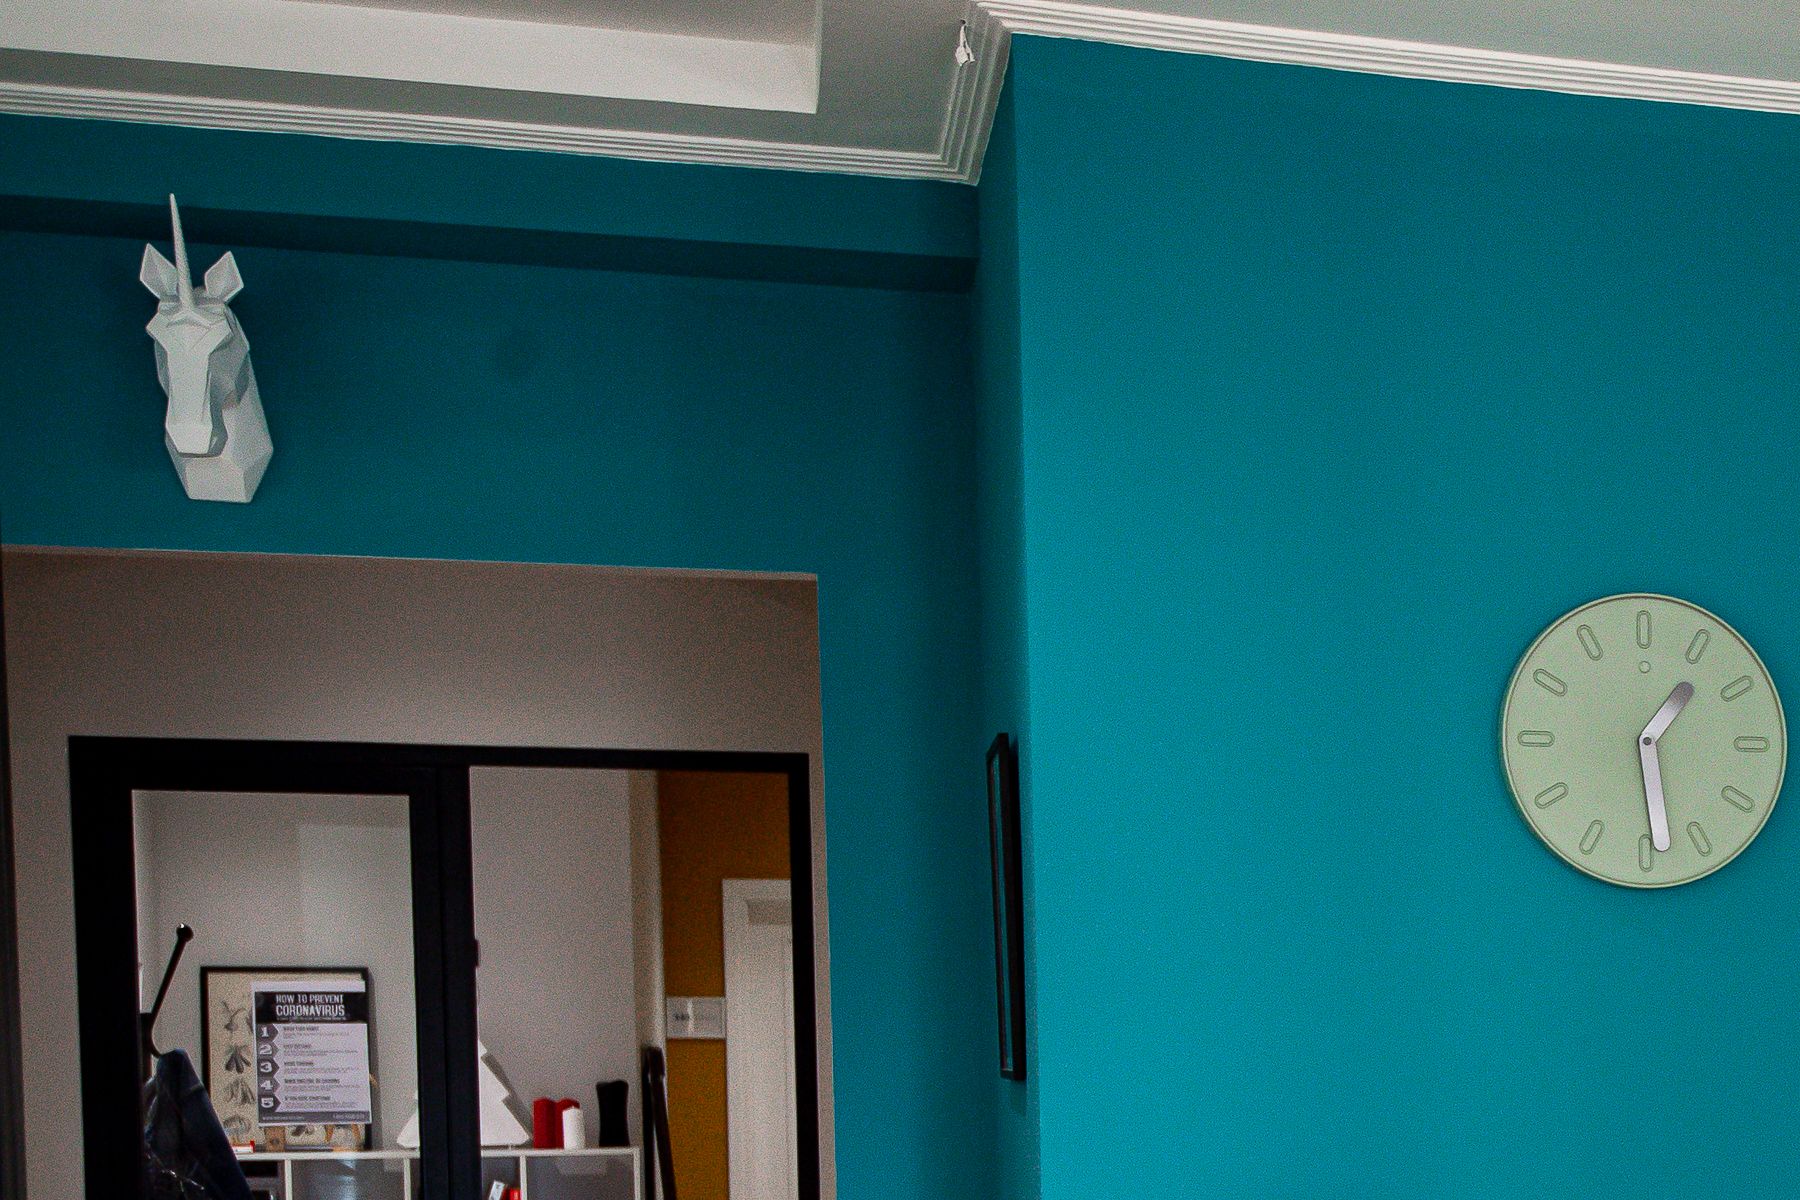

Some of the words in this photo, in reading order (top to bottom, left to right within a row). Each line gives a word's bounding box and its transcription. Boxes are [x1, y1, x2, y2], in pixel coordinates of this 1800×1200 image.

[275, 994, 295, 1004] HOW
[298, 994, 307, 1004] TO
[310, 994, 344, 1004] PREVENT
[276, 1004, 345, 1016] CORONAVIRUS
[262, 1026, 269, 1037] 1
[260, 1044, 272, 1055] 2
[261, 1061, 272, 1073] 3
[261, 1080, 273, 1090] 4
[261, 1098, 274, 1108] 5
